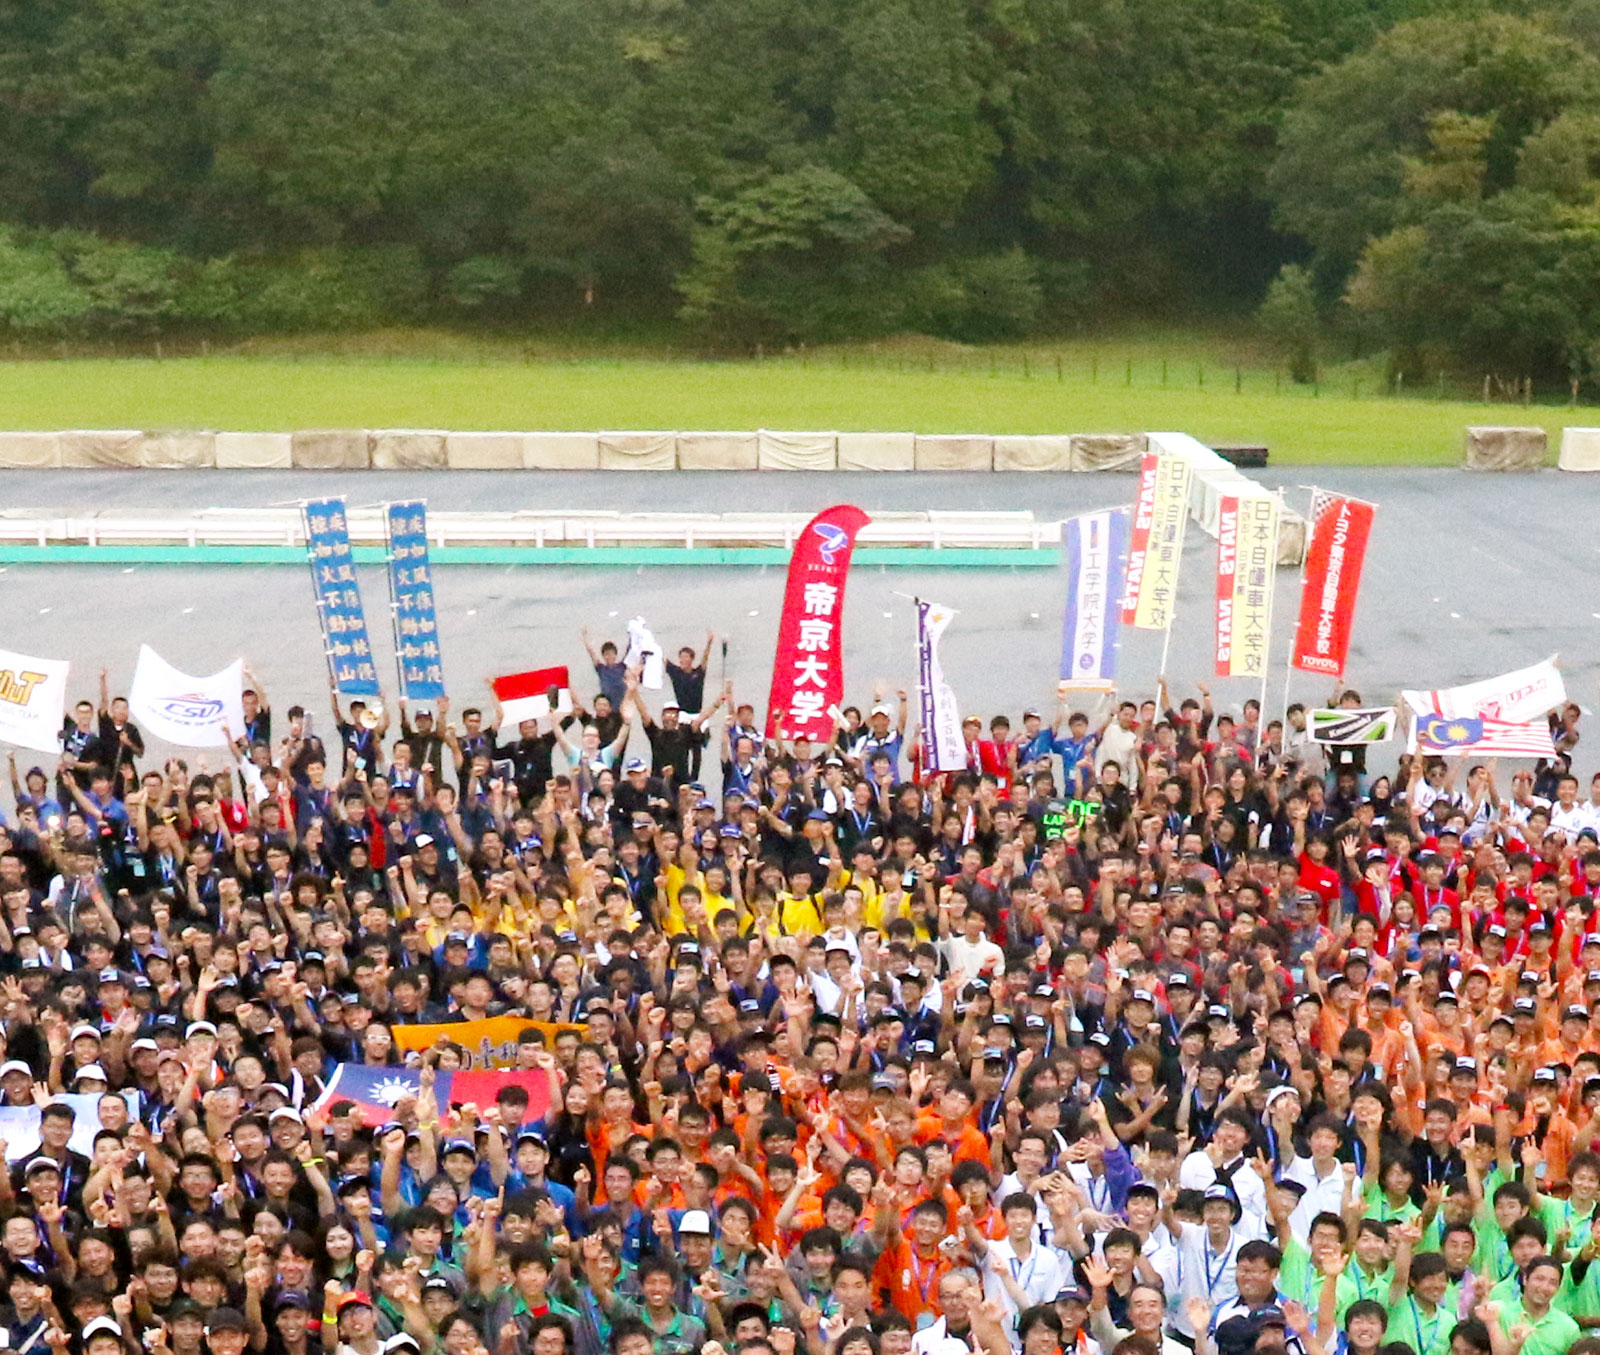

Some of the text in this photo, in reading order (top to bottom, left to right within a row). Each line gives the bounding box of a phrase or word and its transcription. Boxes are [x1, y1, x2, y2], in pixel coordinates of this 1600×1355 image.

[789, 582, 838, 725] 帝京大学
[1302, 655, 1339, 671] TOYOTA
